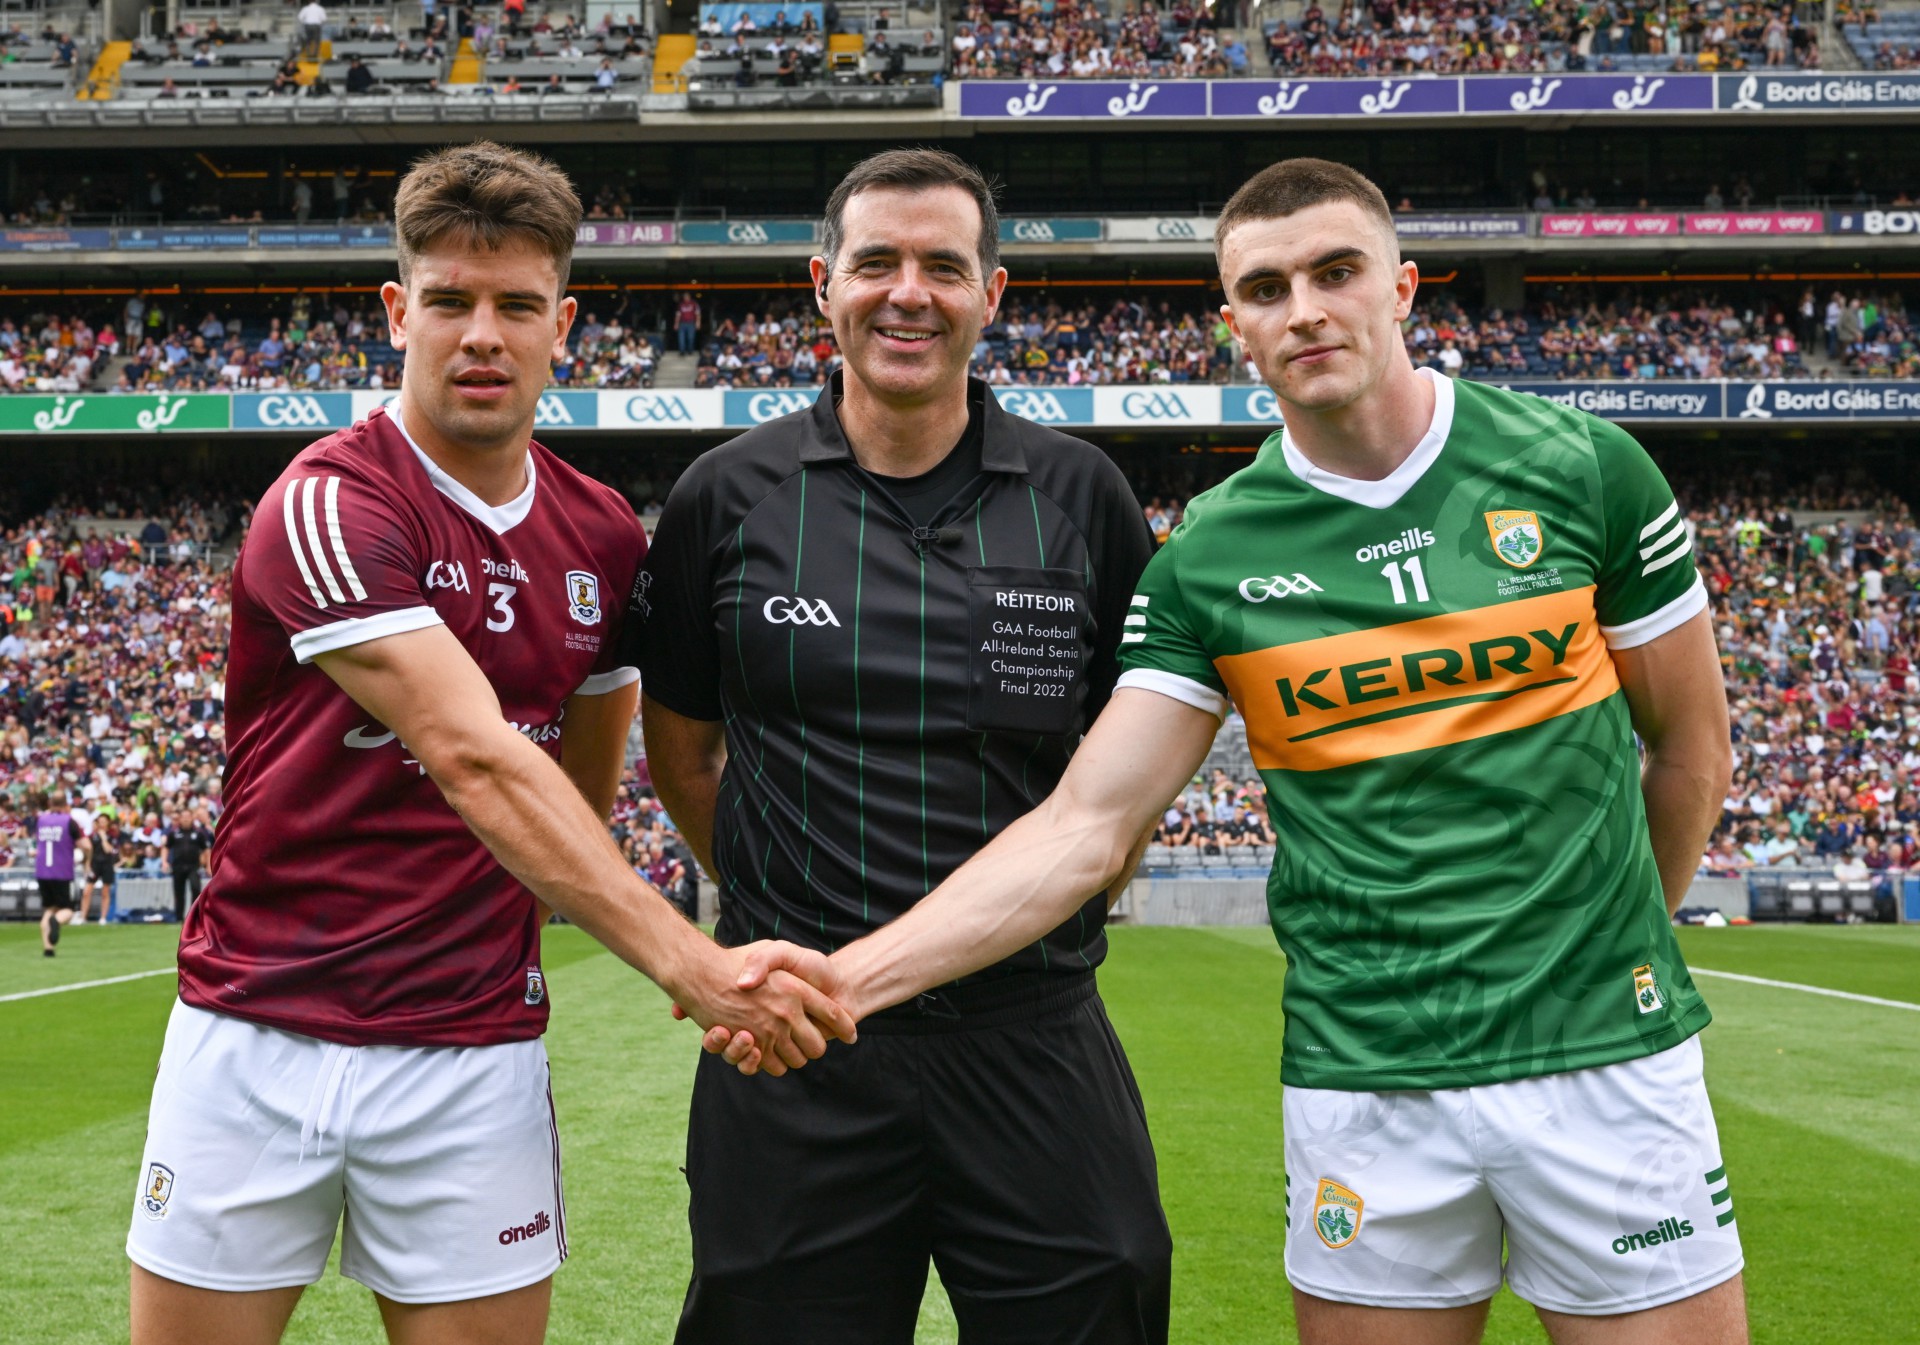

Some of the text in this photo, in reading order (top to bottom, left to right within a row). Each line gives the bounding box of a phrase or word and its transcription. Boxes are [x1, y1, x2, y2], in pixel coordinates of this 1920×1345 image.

[1006, 83, 1057, 117] eir
[1107, 82, 1159, 117] eir
[1257, 81, 1309, 115] eir
[1360, 79, 1412, 114] eir
[1510, 77, 1562, 111] eir
[1612, 75, 1665, 110] eir
[1766, 80, 1920, 102] Bord Gáis Ene
[632, 225, 664, 242] AIB
[728, 223, 768, 242] GAA
[1013, 221, 1055, 240] GAA
[1156, 220, 1196, 238] GAA
[1469, 220, 1519, 233] EVENTS
[1549, 217, 1669, 234] very very very
[1693, 216, 1814, 233] very very very
[137, 395, 188, 429] eir
[258, 396, 329, 425] GAA
[625, 395, 693, 422] GAA
[1122, 392, 1191, 419] GAA
[1578, 389, 1627, 411] Gáis
[1629, 390, 1708, 414] Energy
[1774, 390, 1830, 410] Bord
[1832, 388, 1881, 410] Gáis
[34, 396, 84, 430] eir
[1356, 527, 1436, 563] o'neills
[1238, 573, 1326, 603] GAA
[1380, 555, 1430, 604] 11
[1497, 567, 1559, 588] ALL IRELAND SENIOR
[1498, 583, 1532, 596] FOOTBALL
[1532, 579, 1550, 589] FINAL
[486, 582, 517, 633] 3
[763, 595, 842, 627] GAA
[996, 589, 1075, 613] RÉITEOIR
[993, 621, 1076, 639] GAA Football
[981, 639, 1044, 657] All-Ireland
[991, 660, 1075, 681] Championship
[1276, 622, 1580, 717] KERRY
[1001, 680, 1065, 697] Final 2022
[499, 1210, 550, 1245] o'neills
[1612, 1216, 1694, 1254] o'neills
